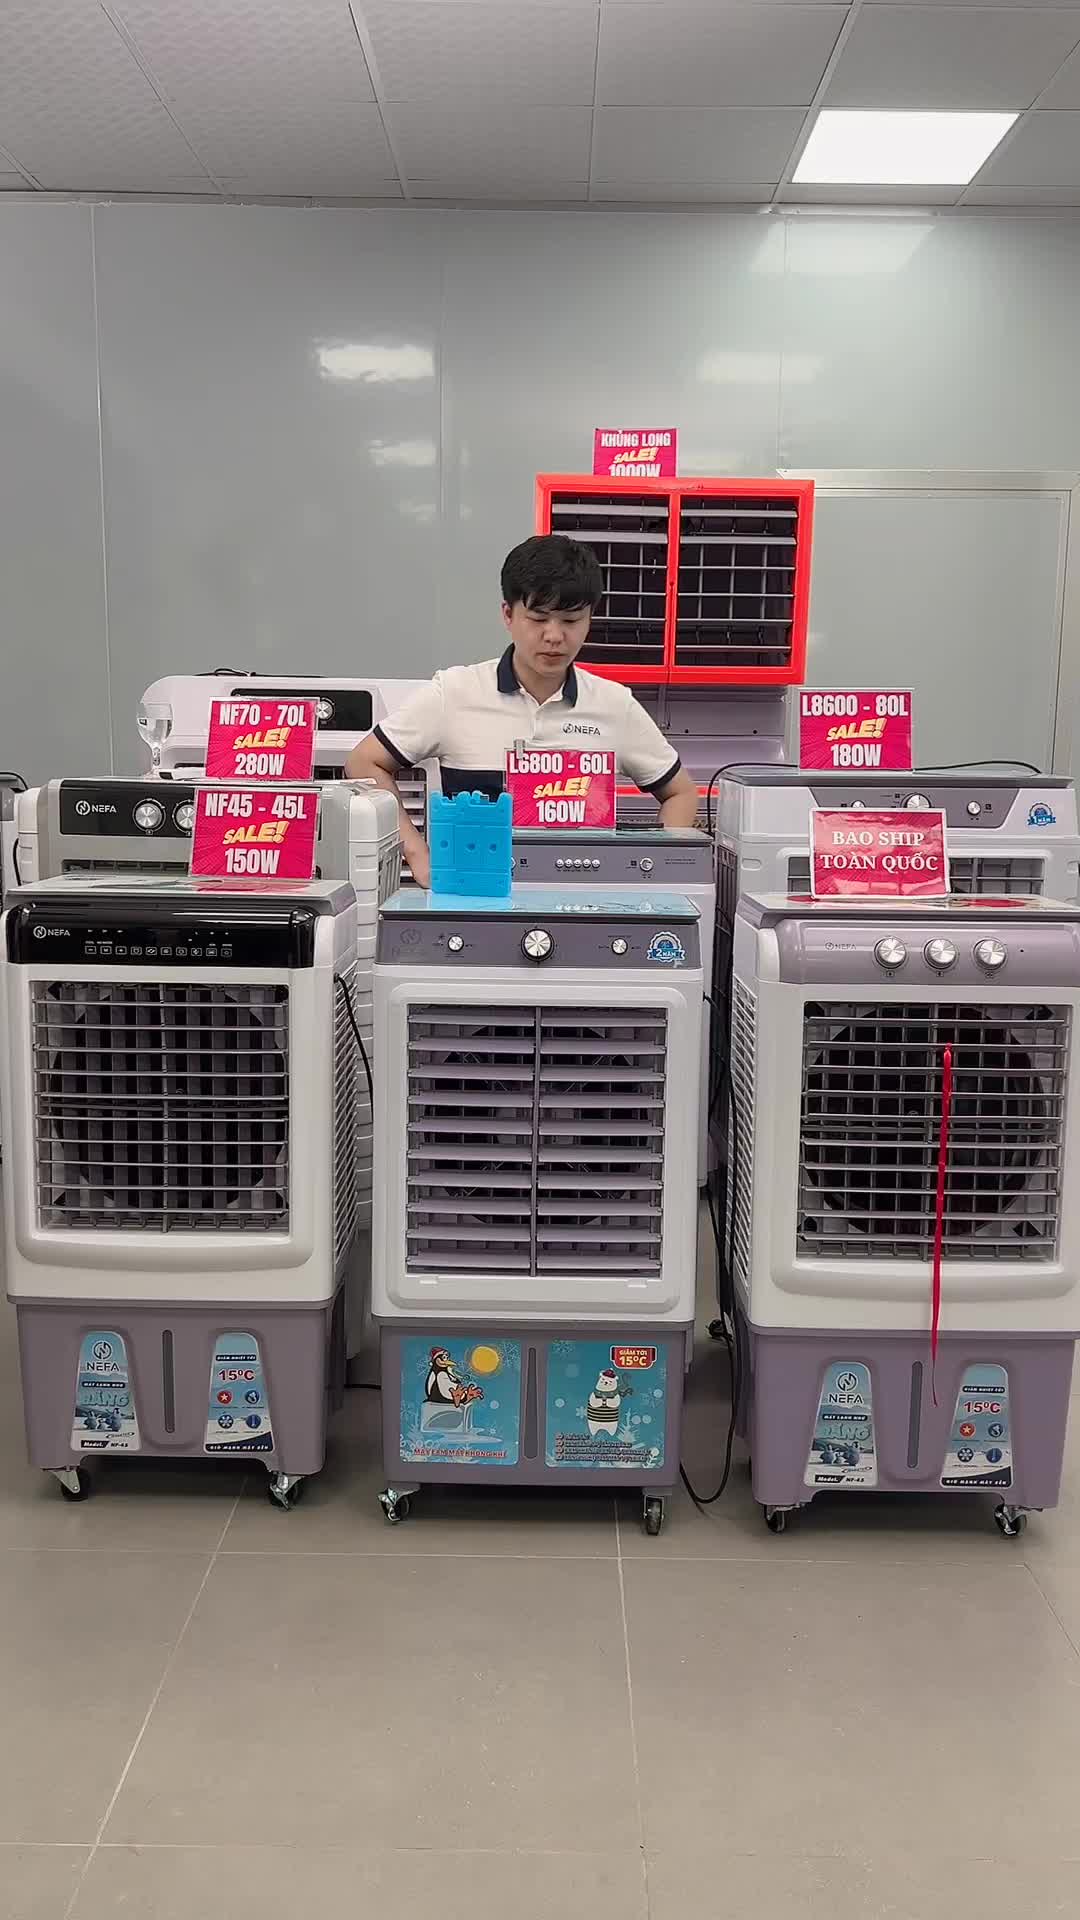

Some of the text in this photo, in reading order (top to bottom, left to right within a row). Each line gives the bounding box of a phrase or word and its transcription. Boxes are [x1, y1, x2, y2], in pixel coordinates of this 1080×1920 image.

[601, 430, 671, 447] KHỦNG LONG
[613, 447, 659, 464] SALE!
[220, 703, 261, 726] NF70
[277, 704, 307, 727] 70L
[802, 694, 858, 716] L8600
[875, 694, 909, 716] 80L
[232, 727, 292, 750] SALE!
[574, 724, 601, 736] NEFA
[826, 717, 887, 742] SALE!
[234, 753, 285, 776] 280W
[509, 753, 563, 774] L6800
[580, 753, 611, 775] 60L
[830, 744, 882, 767] 180W
[533, 776, 592, 799] SALE!
[91, 804, 117, 813] NEFA
[205, 792, 253, 817] NF45
[271, 794, 307, 819] 45L
[536, 800, 586, 823] 160W
[222, 820, 290, 845] SALE!
[832, 831, 924, 846] BAO SHIP
[225, 847, 280, 875] 150W
[820, 851, 939, 874] TOÀN QUỐC
[47, 928, 71, 937] NEFA
[86, 1362, 120, 1371] NEFA
[829, 1393, 863, 1404] NEFA
